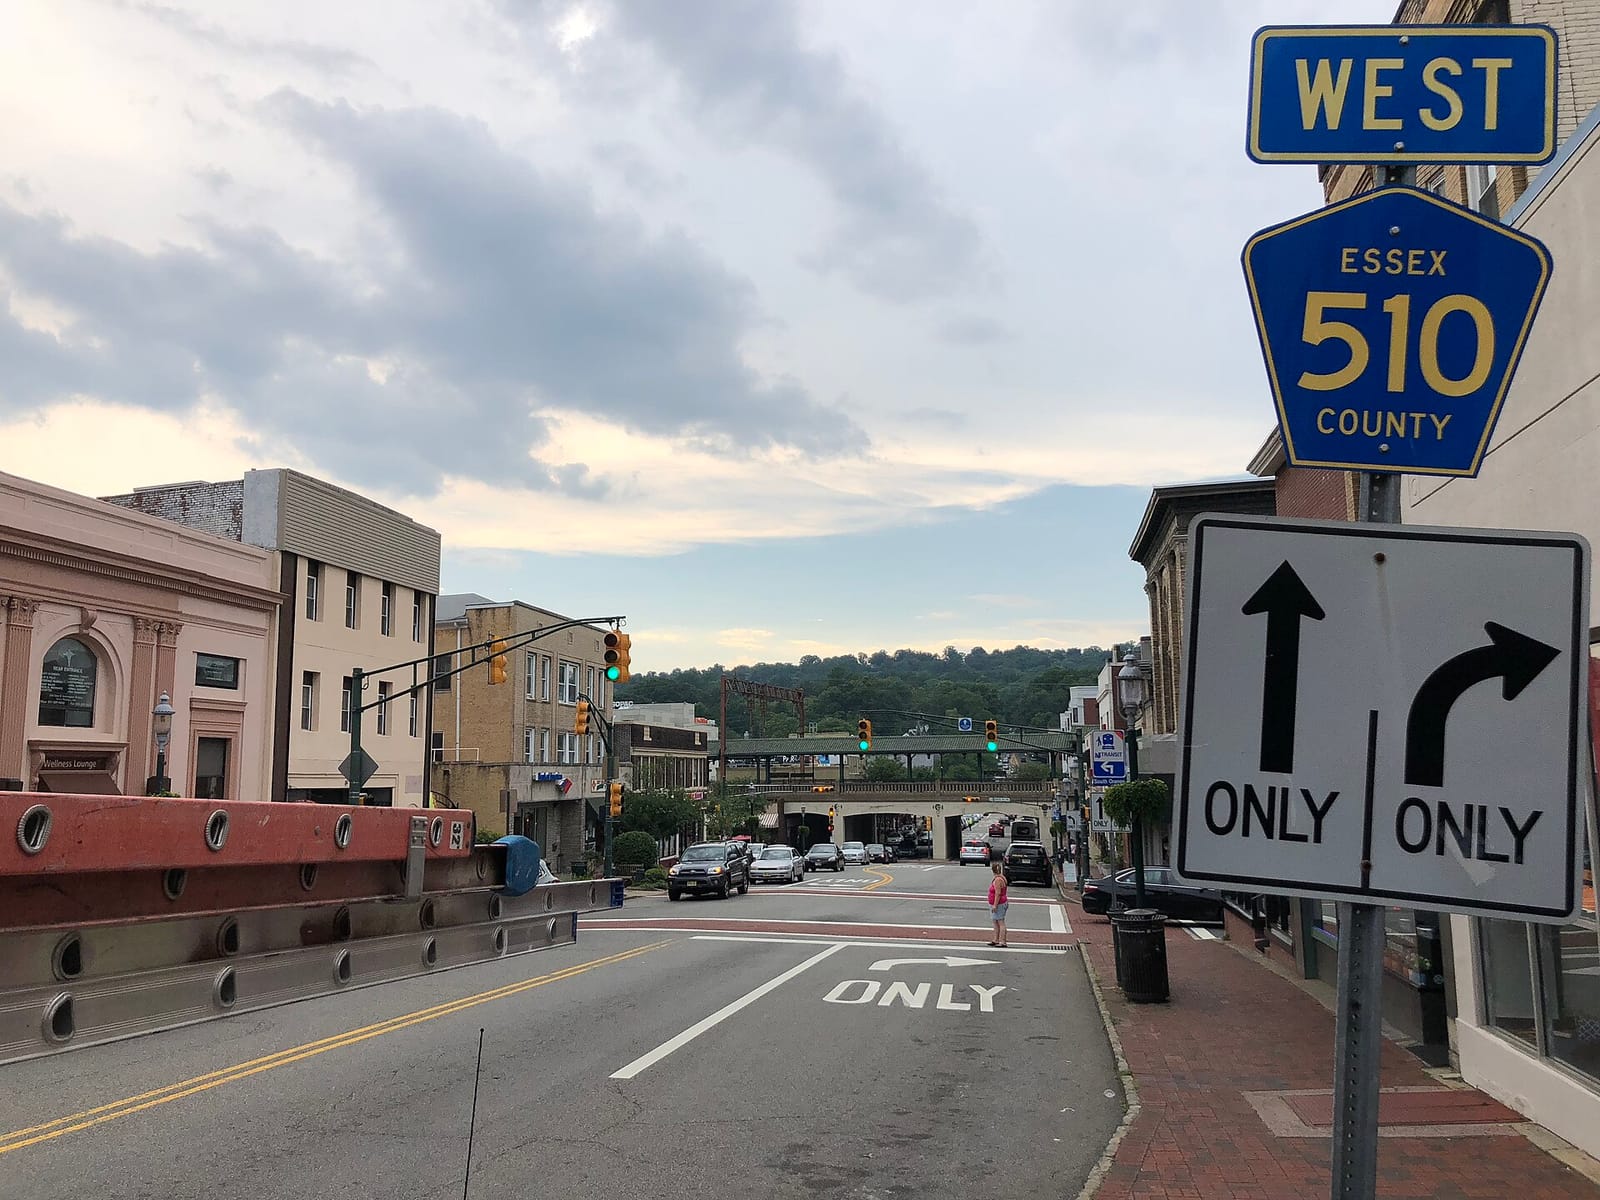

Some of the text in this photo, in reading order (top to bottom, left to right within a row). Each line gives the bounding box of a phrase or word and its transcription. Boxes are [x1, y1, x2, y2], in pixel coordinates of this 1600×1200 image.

[1295, 57, 1512, 131] WEST
[1340, 248, 1448, 275] ESSEX
[1297, 291, 1495, 397] 510
[1316, 408, 1452, 440] COUNTY
[73, 760, 97, 770] Lounge
[1204, 781, 1340, 844] ONLY
[1395, 797, 1543, 865] ONLY
[822, 980, 1006, 1012] ONLY
